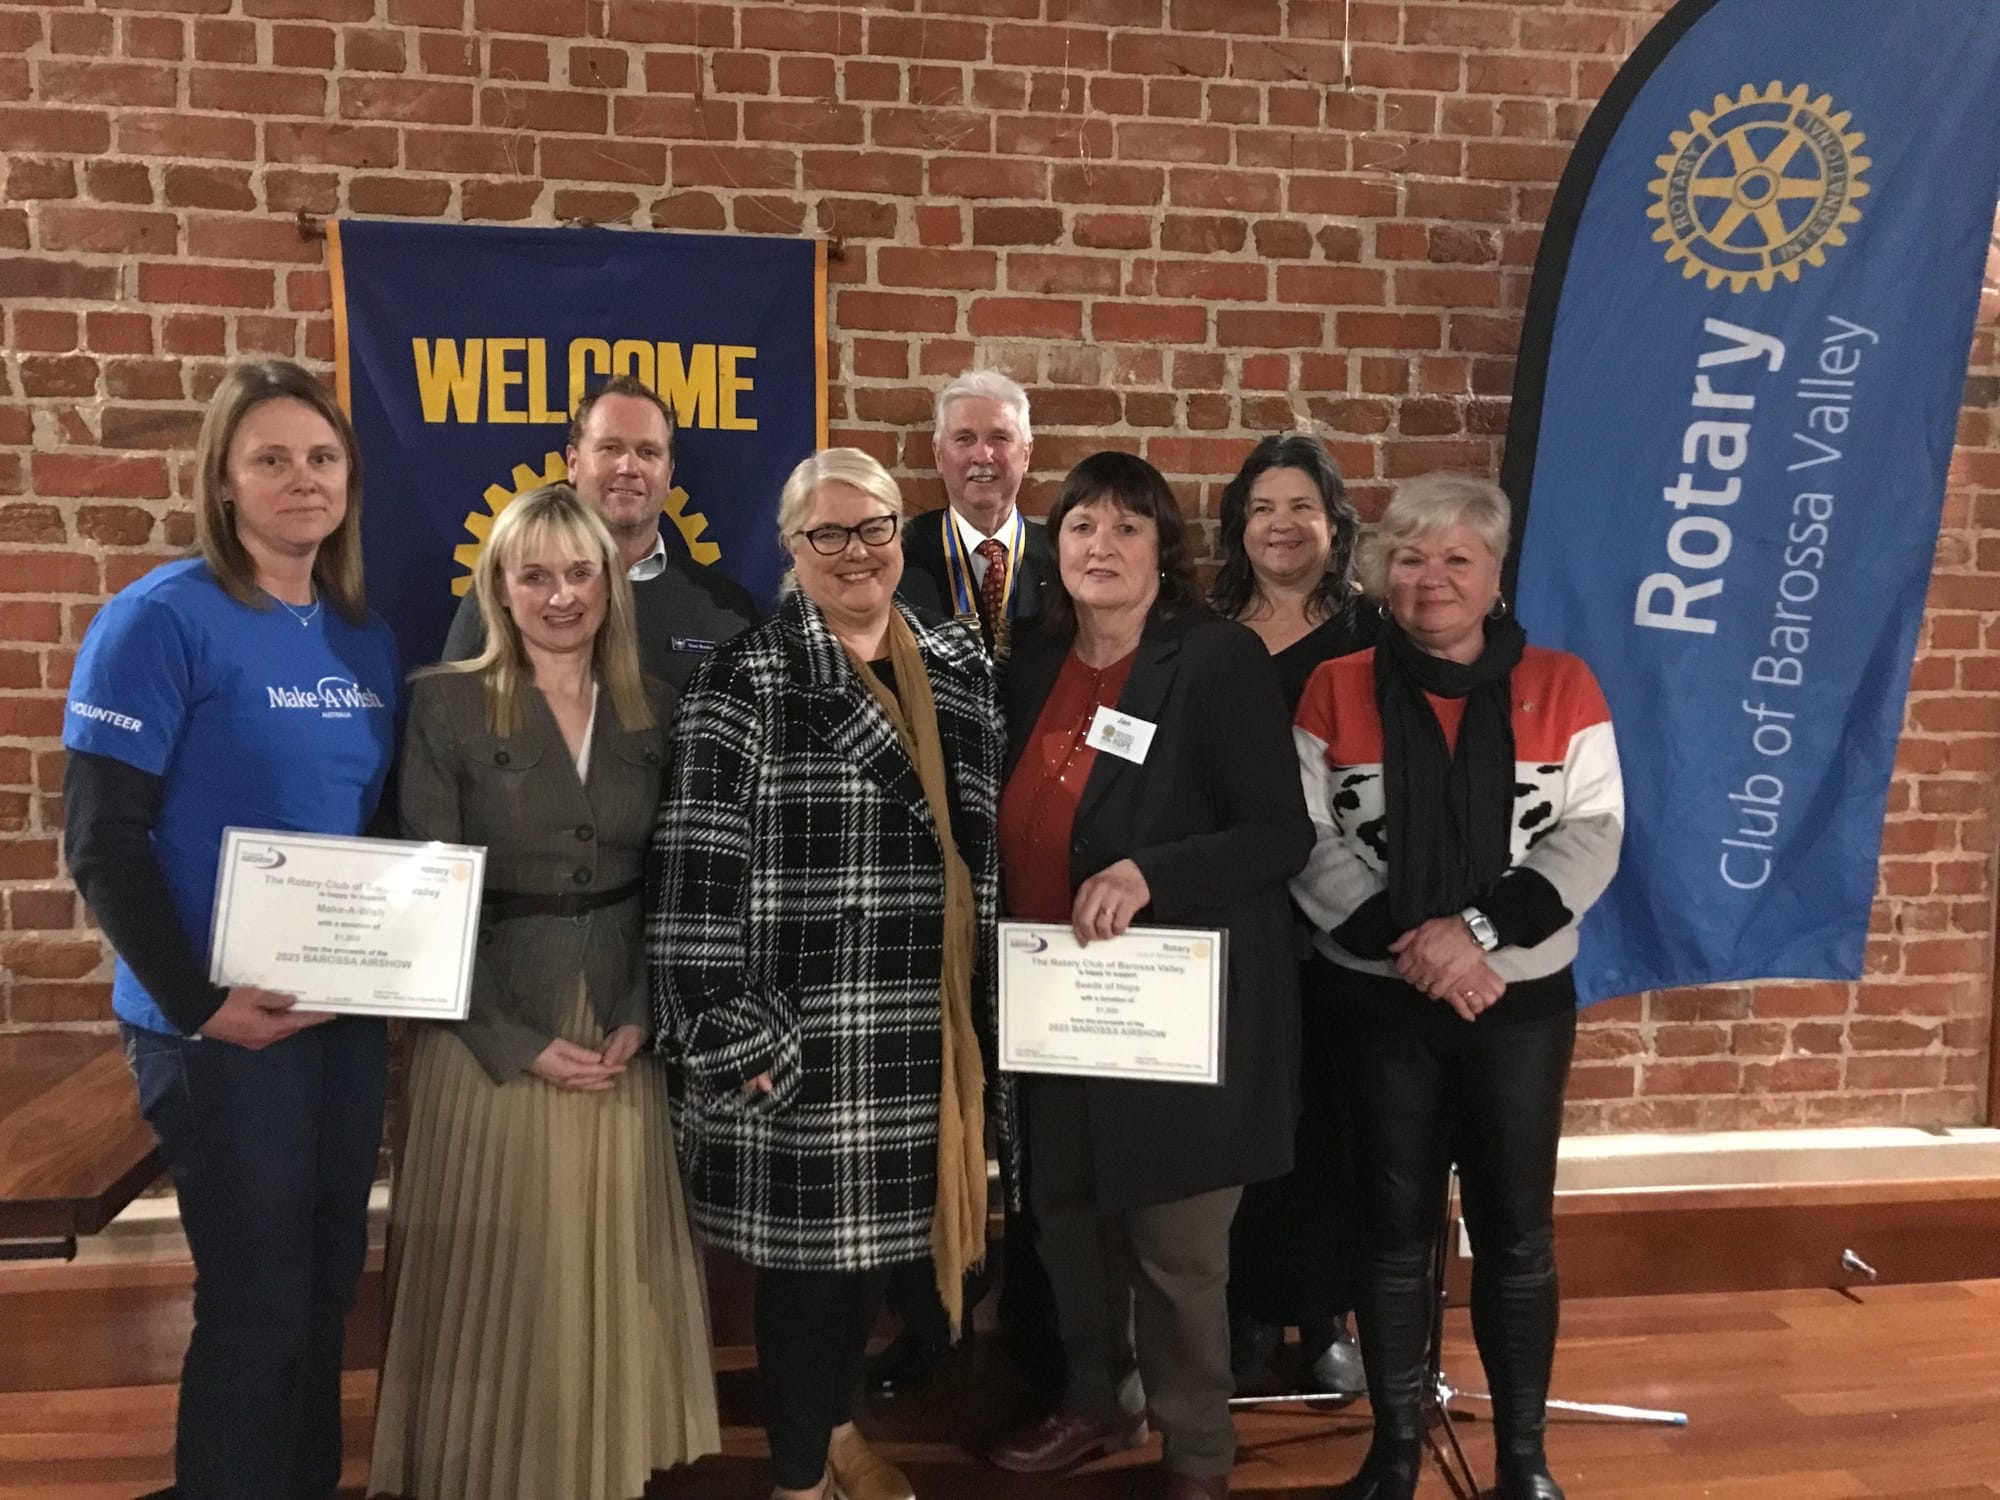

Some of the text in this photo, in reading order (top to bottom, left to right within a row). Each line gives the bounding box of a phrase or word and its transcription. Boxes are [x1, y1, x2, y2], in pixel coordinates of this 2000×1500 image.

[1670, 146, 1701, 230] ROTARY
[1780, 118, 1847, 260] INTERNATIONAL
[412, 337, 758, 431] WELCOME
[1634, 317, 1786, 634] Rotary
[1720, 315, 1879, 890] Club of Barossa Valley
[70, 701, 143, 733] VOLUNTEER
[264, 874, 284, 885] The
[287, 876, 322, 890] Rotary
[325, 879, 350, 890] Club
[352, 881, 363, 891] of
[275, 952, 412, 970] 2023 BAROSSA AIRSHOW
[1032, 957, 1184, 975] The Rotary Club of Barossa Valley
